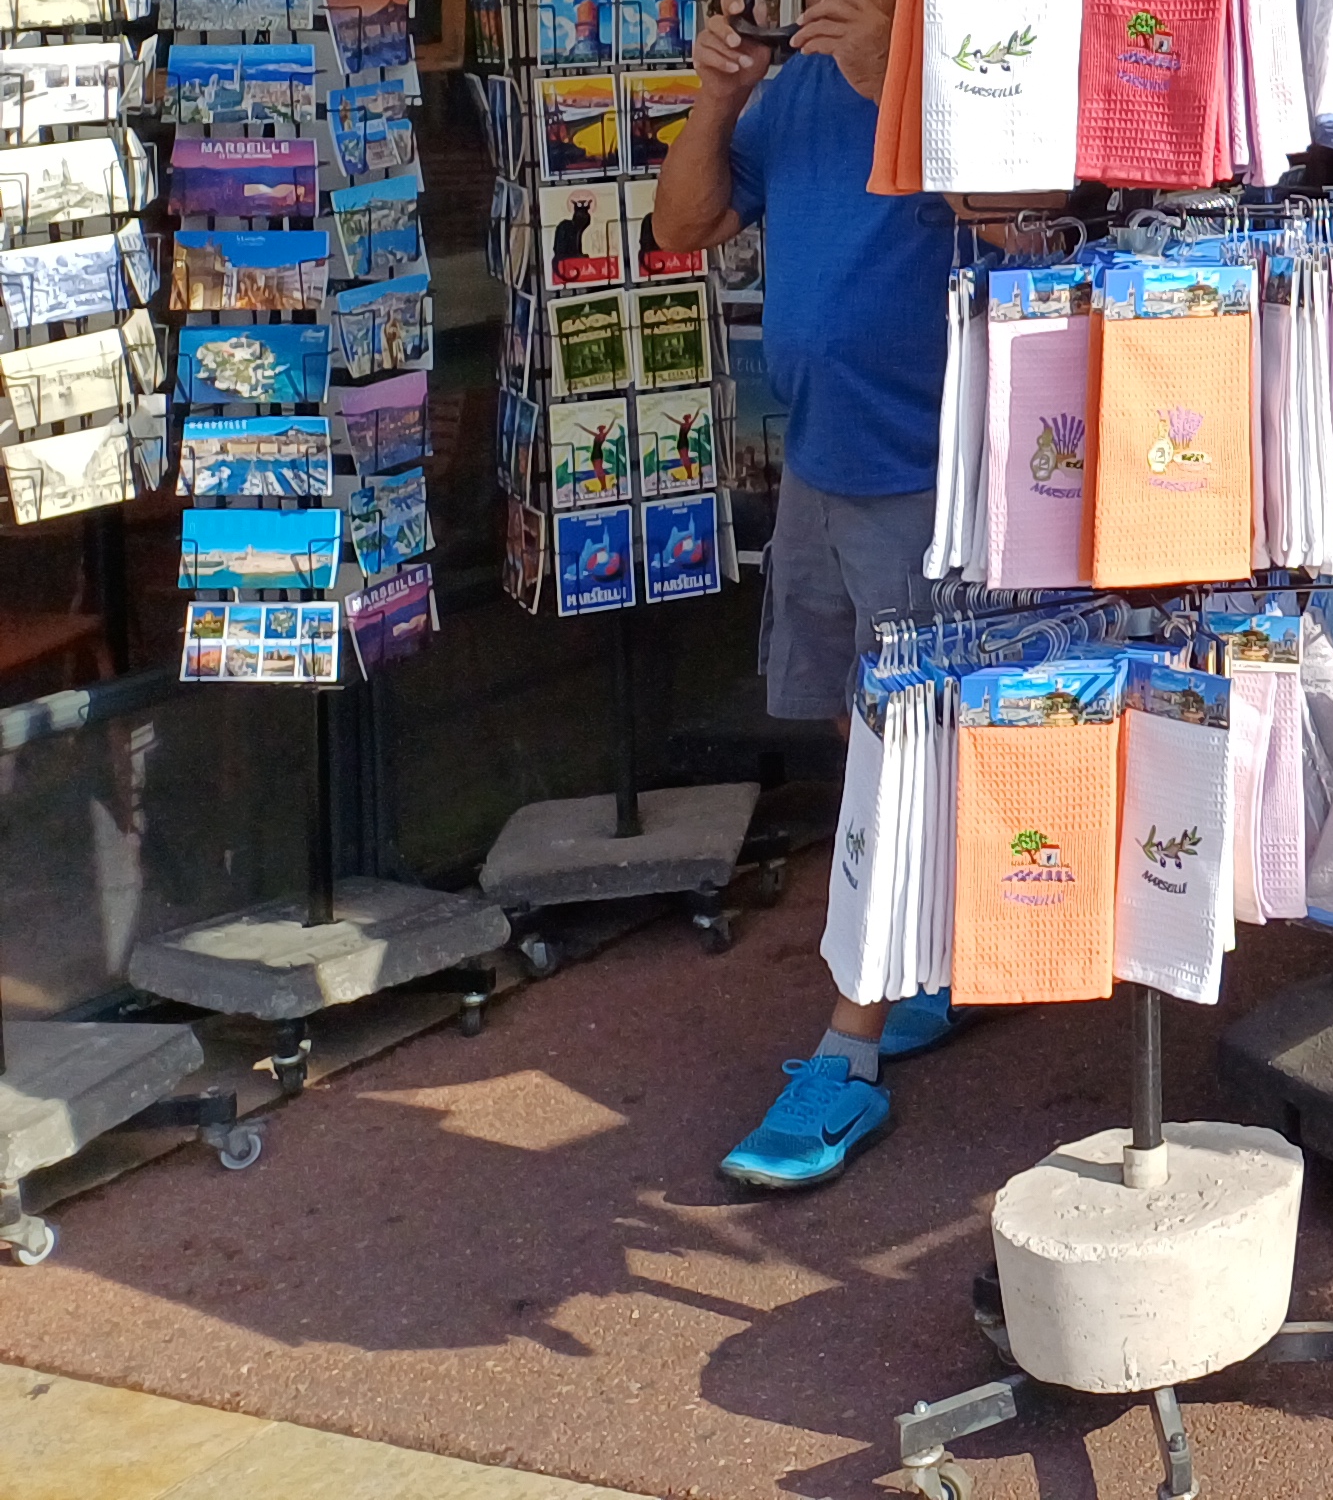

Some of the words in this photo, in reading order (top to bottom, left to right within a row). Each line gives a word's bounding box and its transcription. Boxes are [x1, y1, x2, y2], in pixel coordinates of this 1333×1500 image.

[201, 141, 290, 155] MARSEILLE
[1030, 481, 1082, 499] MARSEIL
[1142, 869, 1189, 895] MARSEILLE
